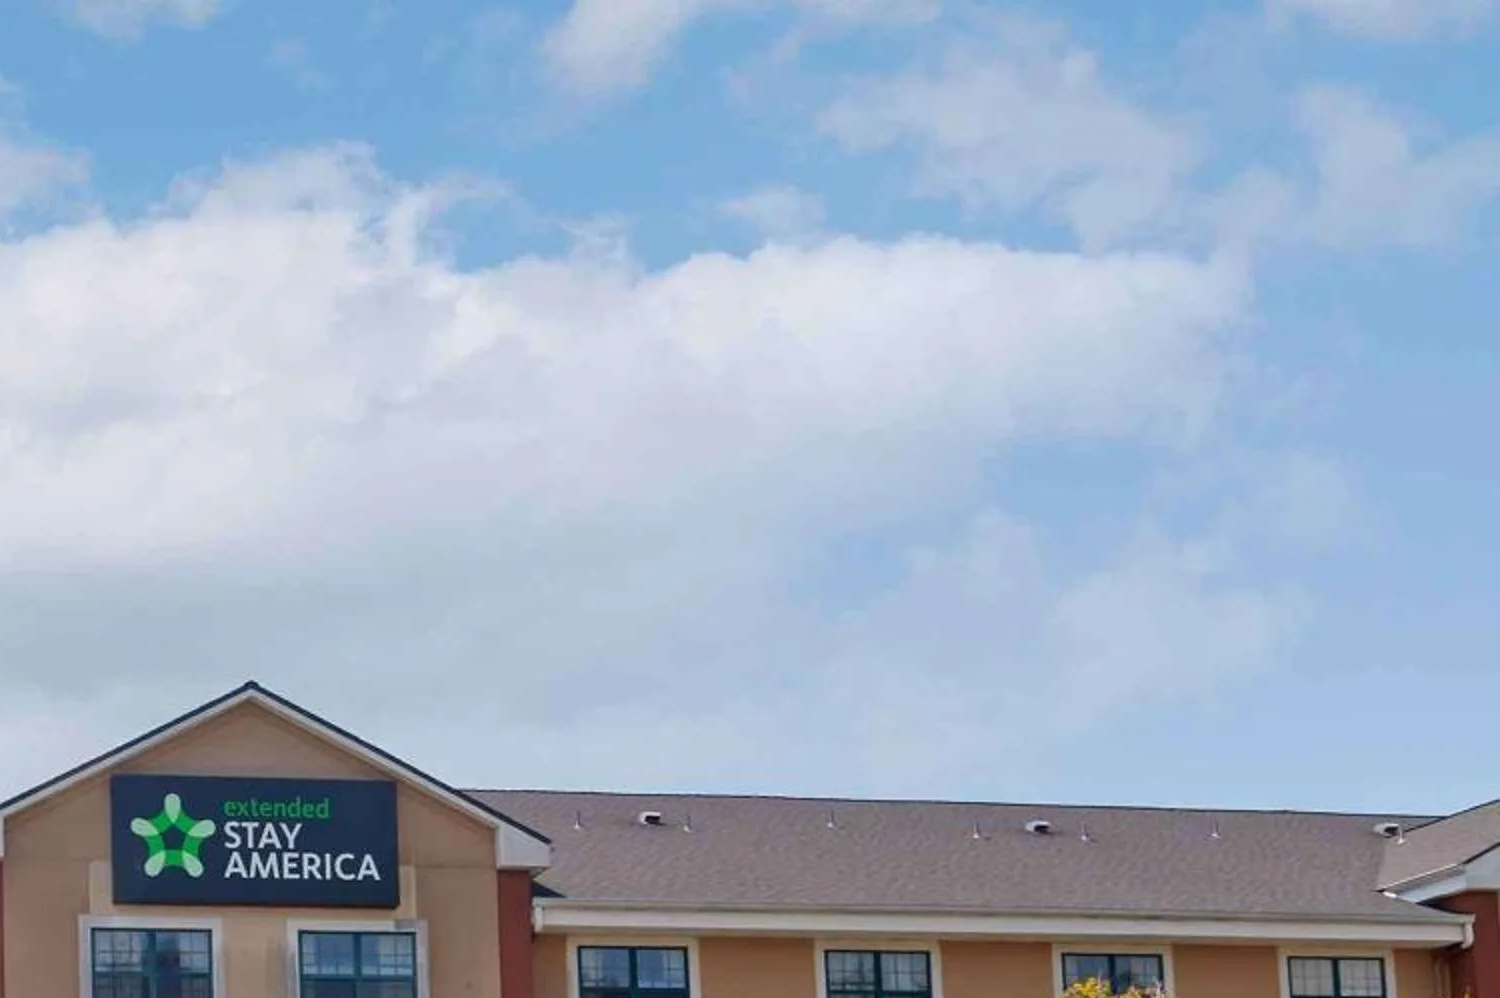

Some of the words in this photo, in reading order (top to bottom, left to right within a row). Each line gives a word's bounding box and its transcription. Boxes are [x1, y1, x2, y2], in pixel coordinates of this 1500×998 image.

[223, 797, 331, 819] extended
[223, 822, 302, 849] STAY
[223, 852, 381, 881] AMERICA
